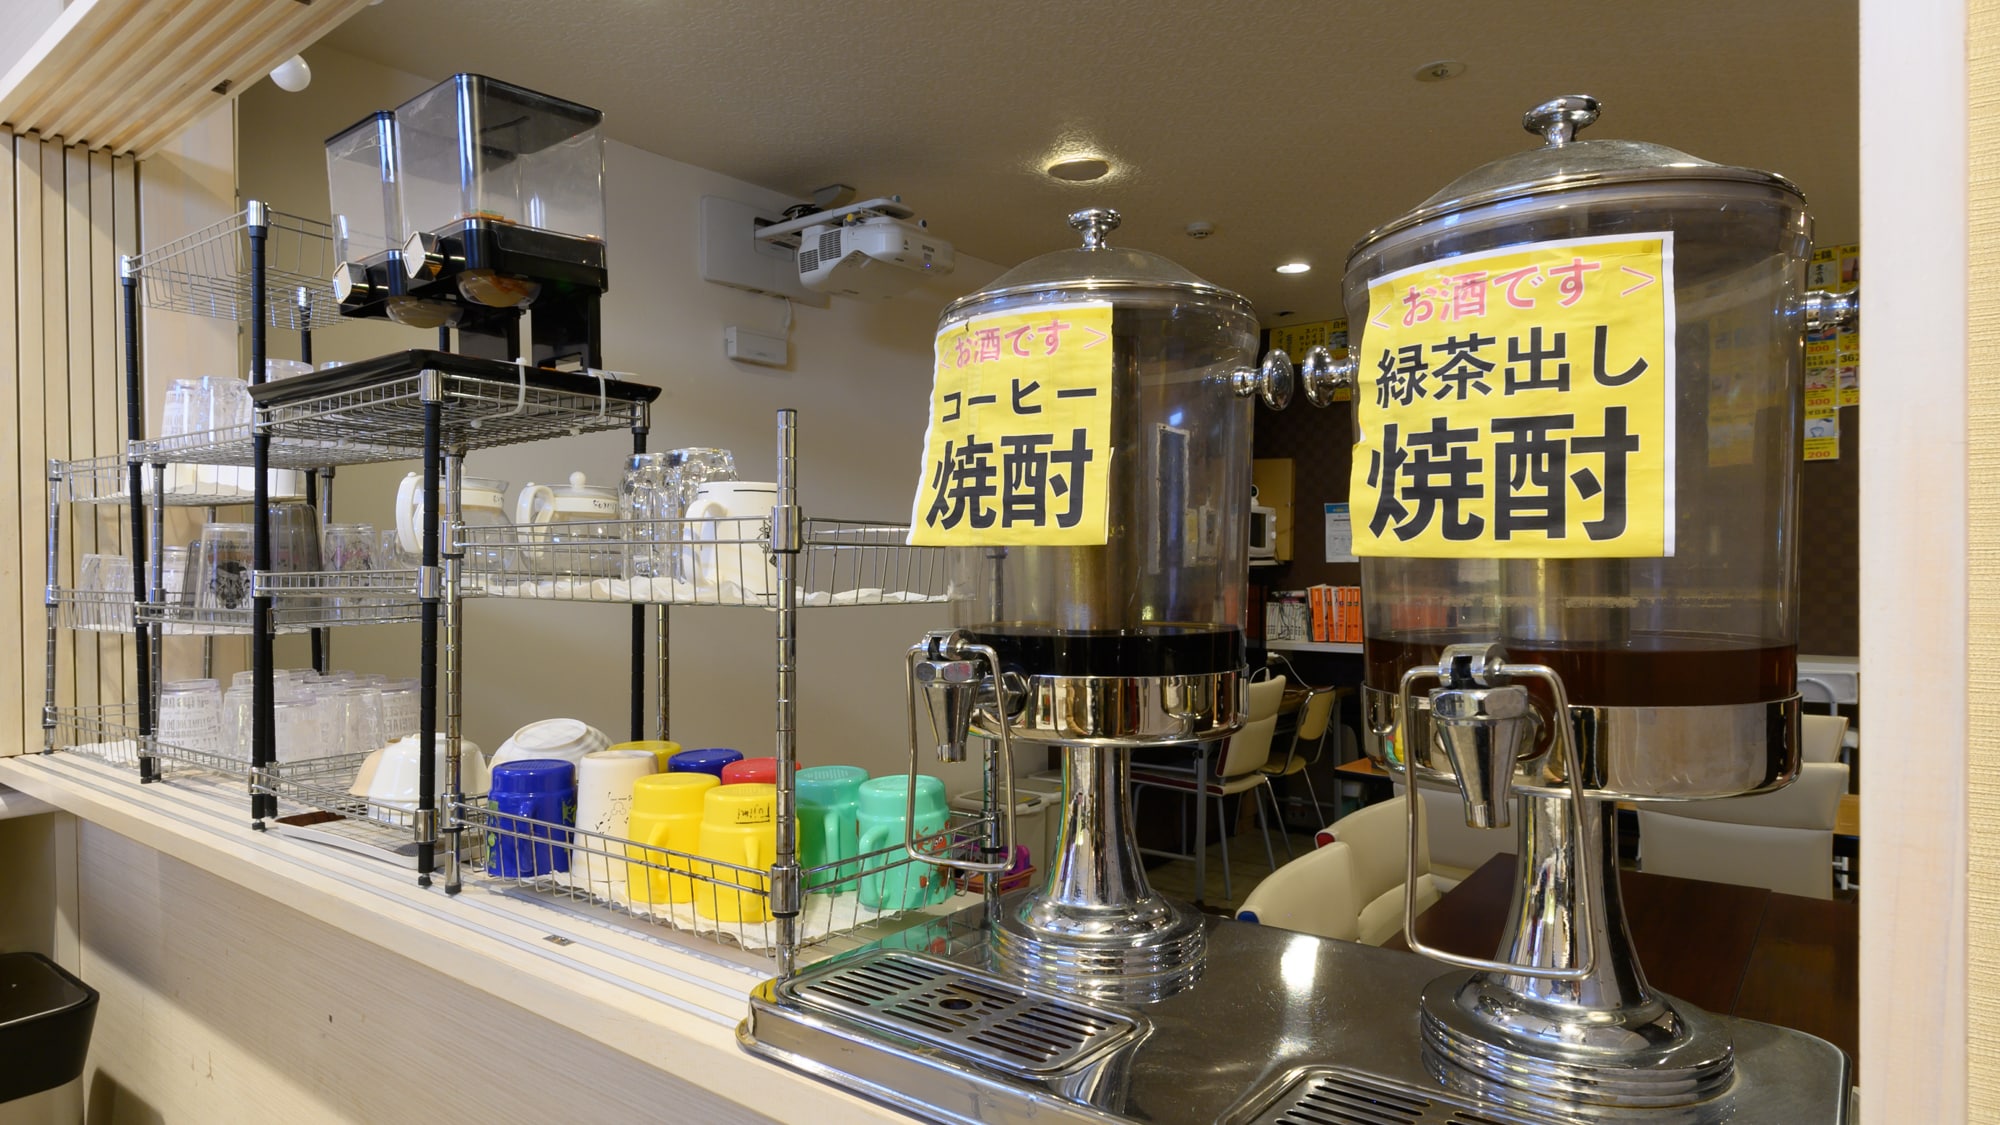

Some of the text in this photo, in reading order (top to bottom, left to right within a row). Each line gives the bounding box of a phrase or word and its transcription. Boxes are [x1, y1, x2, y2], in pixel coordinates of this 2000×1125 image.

[942, 378, 1097, 423] コーヒー
[1375, 325, 1650, 409] 緑茶出し
[1808, 398, 1830, 406] 300
[925, 428, 1094, 530] 焼酎
[1367, 406, 1640, 542] 焼酎
